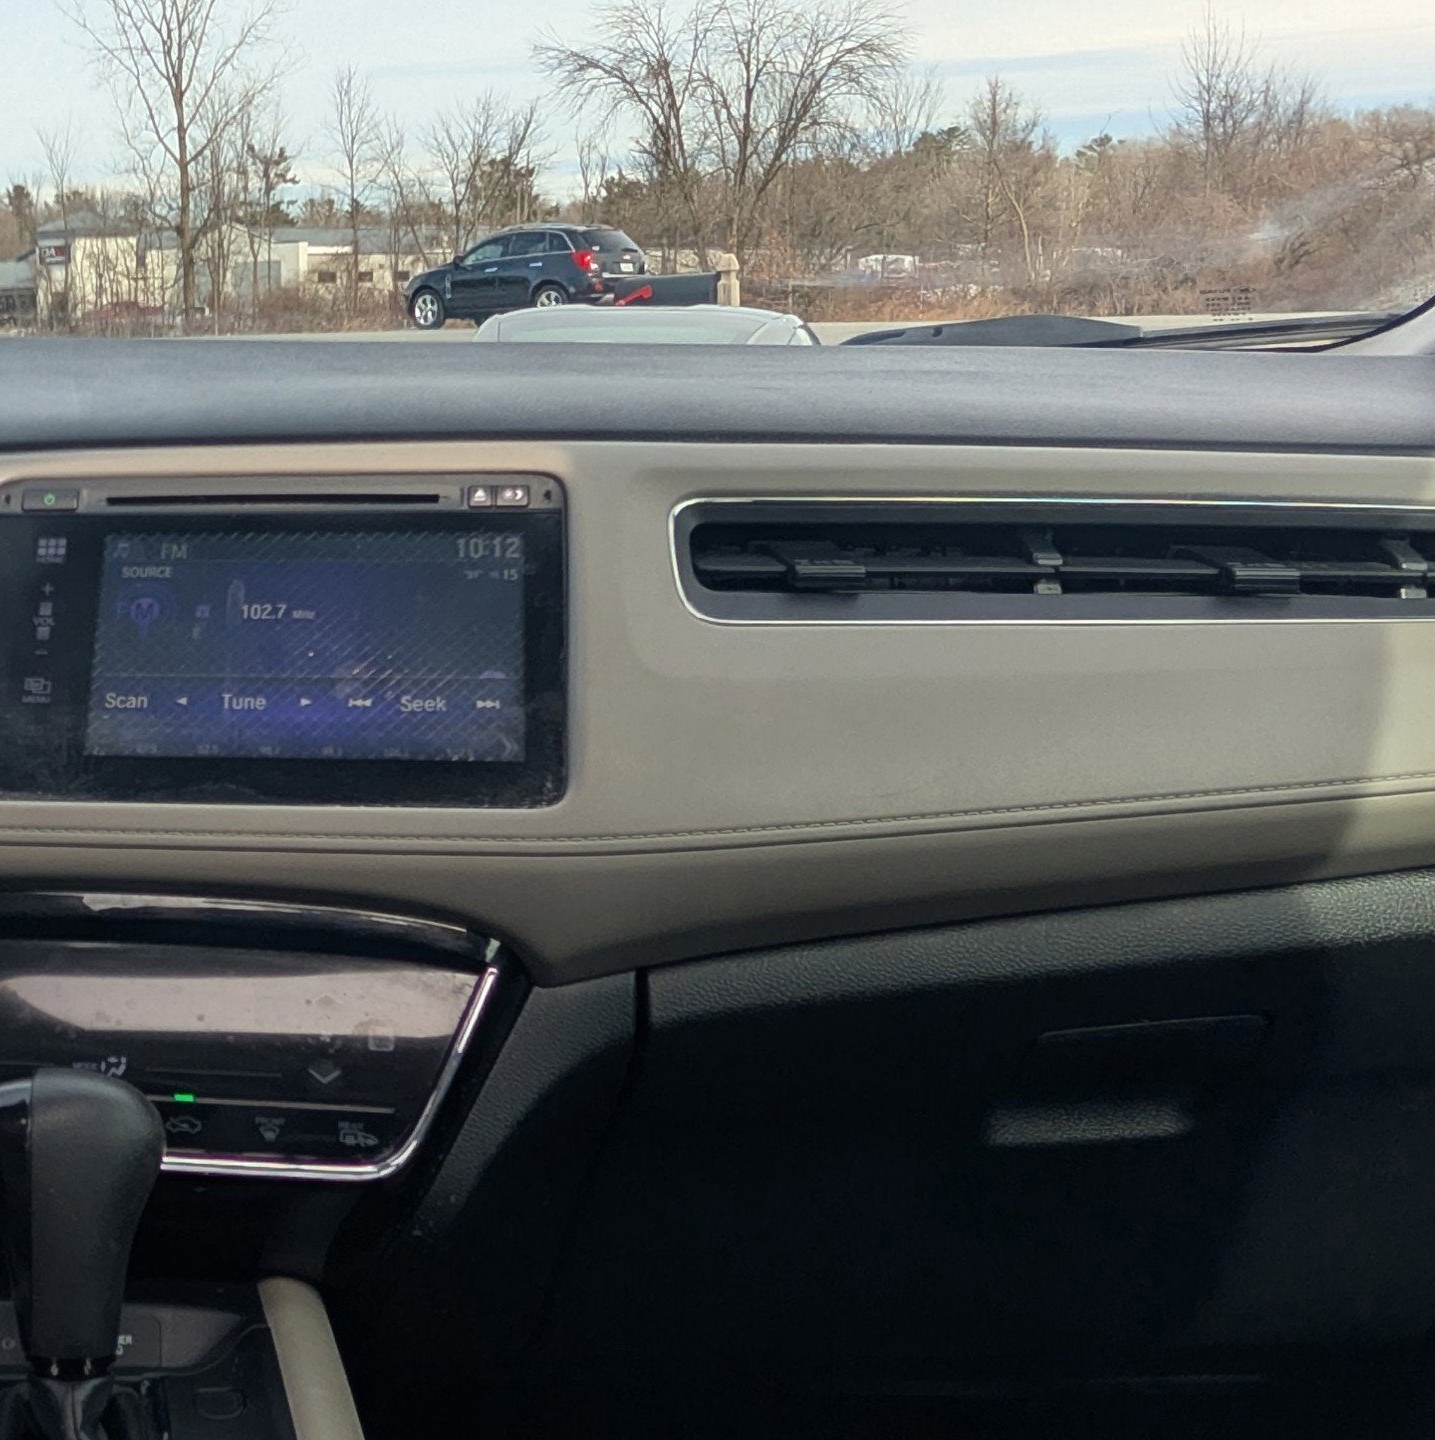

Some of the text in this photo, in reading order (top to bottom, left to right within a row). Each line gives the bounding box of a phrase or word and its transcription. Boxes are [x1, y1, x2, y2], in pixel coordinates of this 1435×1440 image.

[160, 542, 188, 560] FM
[456, 537, 522, 559] 10:12
[121, 565, 174, 578] SOURCE
[503, 568, 519, 581] 15
[242, 603, 288, 620] 102.7
[104, 692, 149, 710] Scan
[221, 693, 267, 711] Tune
[399, 695, 448, 712] Seek
